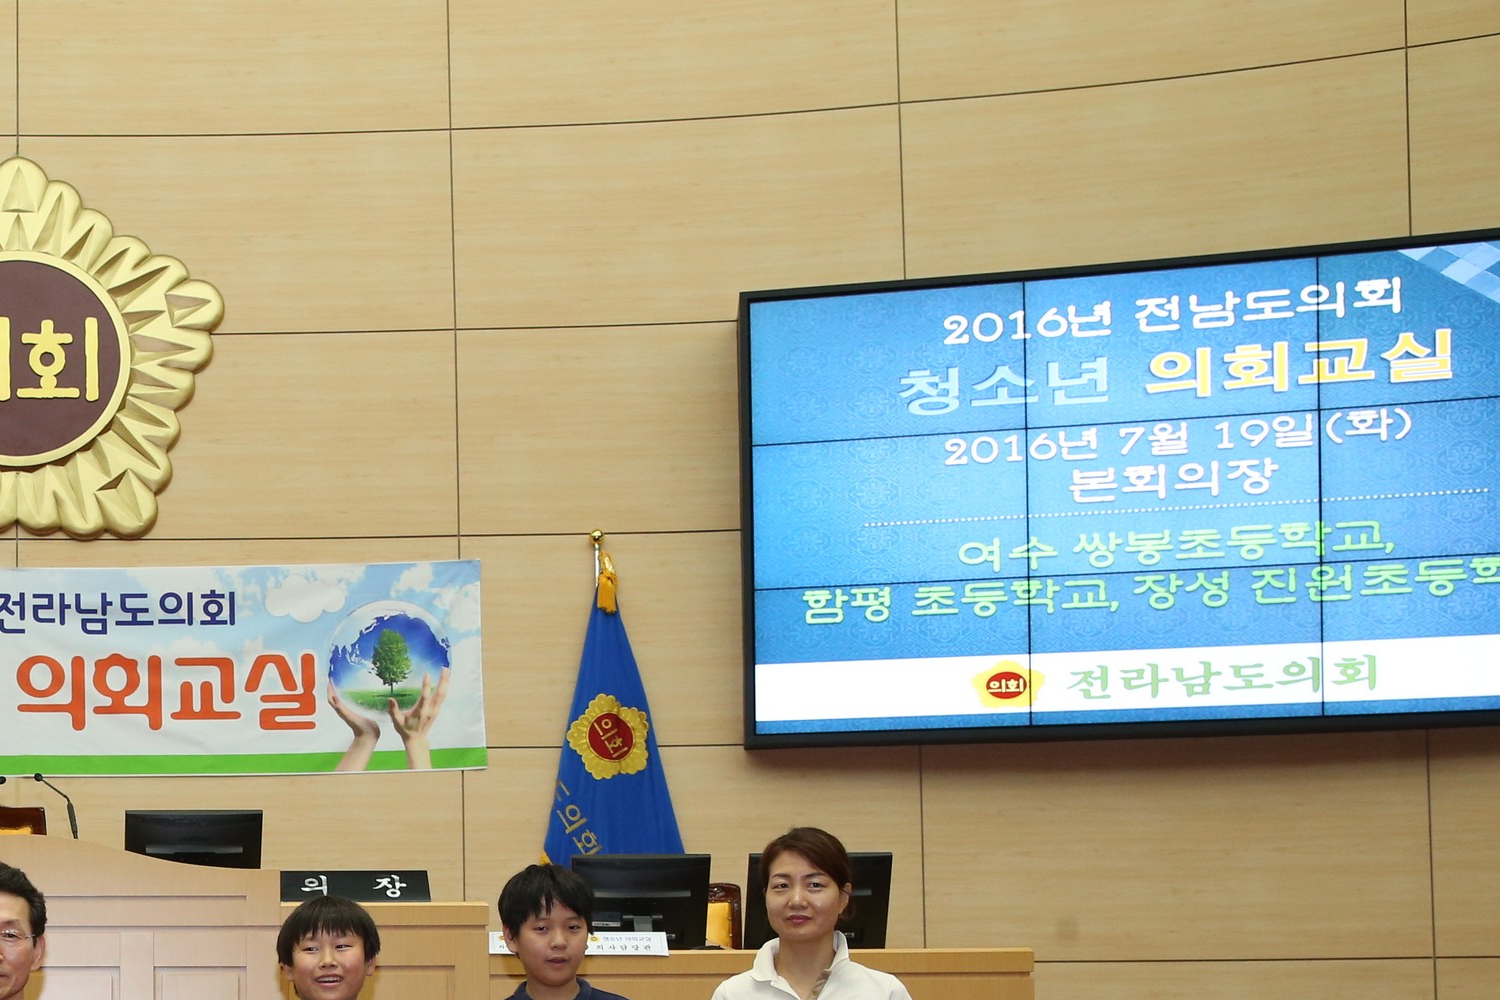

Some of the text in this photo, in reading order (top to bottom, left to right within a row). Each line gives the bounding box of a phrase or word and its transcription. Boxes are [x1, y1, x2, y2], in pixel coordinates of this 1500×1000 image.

[943, 277, 1402, 345] 2016년 전남도의회
[898, 328, 1454, 418] 청소년 의회교실
[944, 430, 1099, 467] 2016년
[1119, 423, 1190, 457] 7월
[1067, 458, 1278, 506] 본회의장
[958, 519, 1395, 572] 여수 쌍봉초등학교,
[802, 586, 894, 625] 함평
[911, 577, 1120, 618] 초등학교,
[1133, 569, 1232, 610] 장성
[16, 652, 319, 731] 의회교실
[988, 678, 1024, 693] 의회
[1067, 654, 1379, 701] 전라남도의회
[593, 718, 629, 758] 의회
